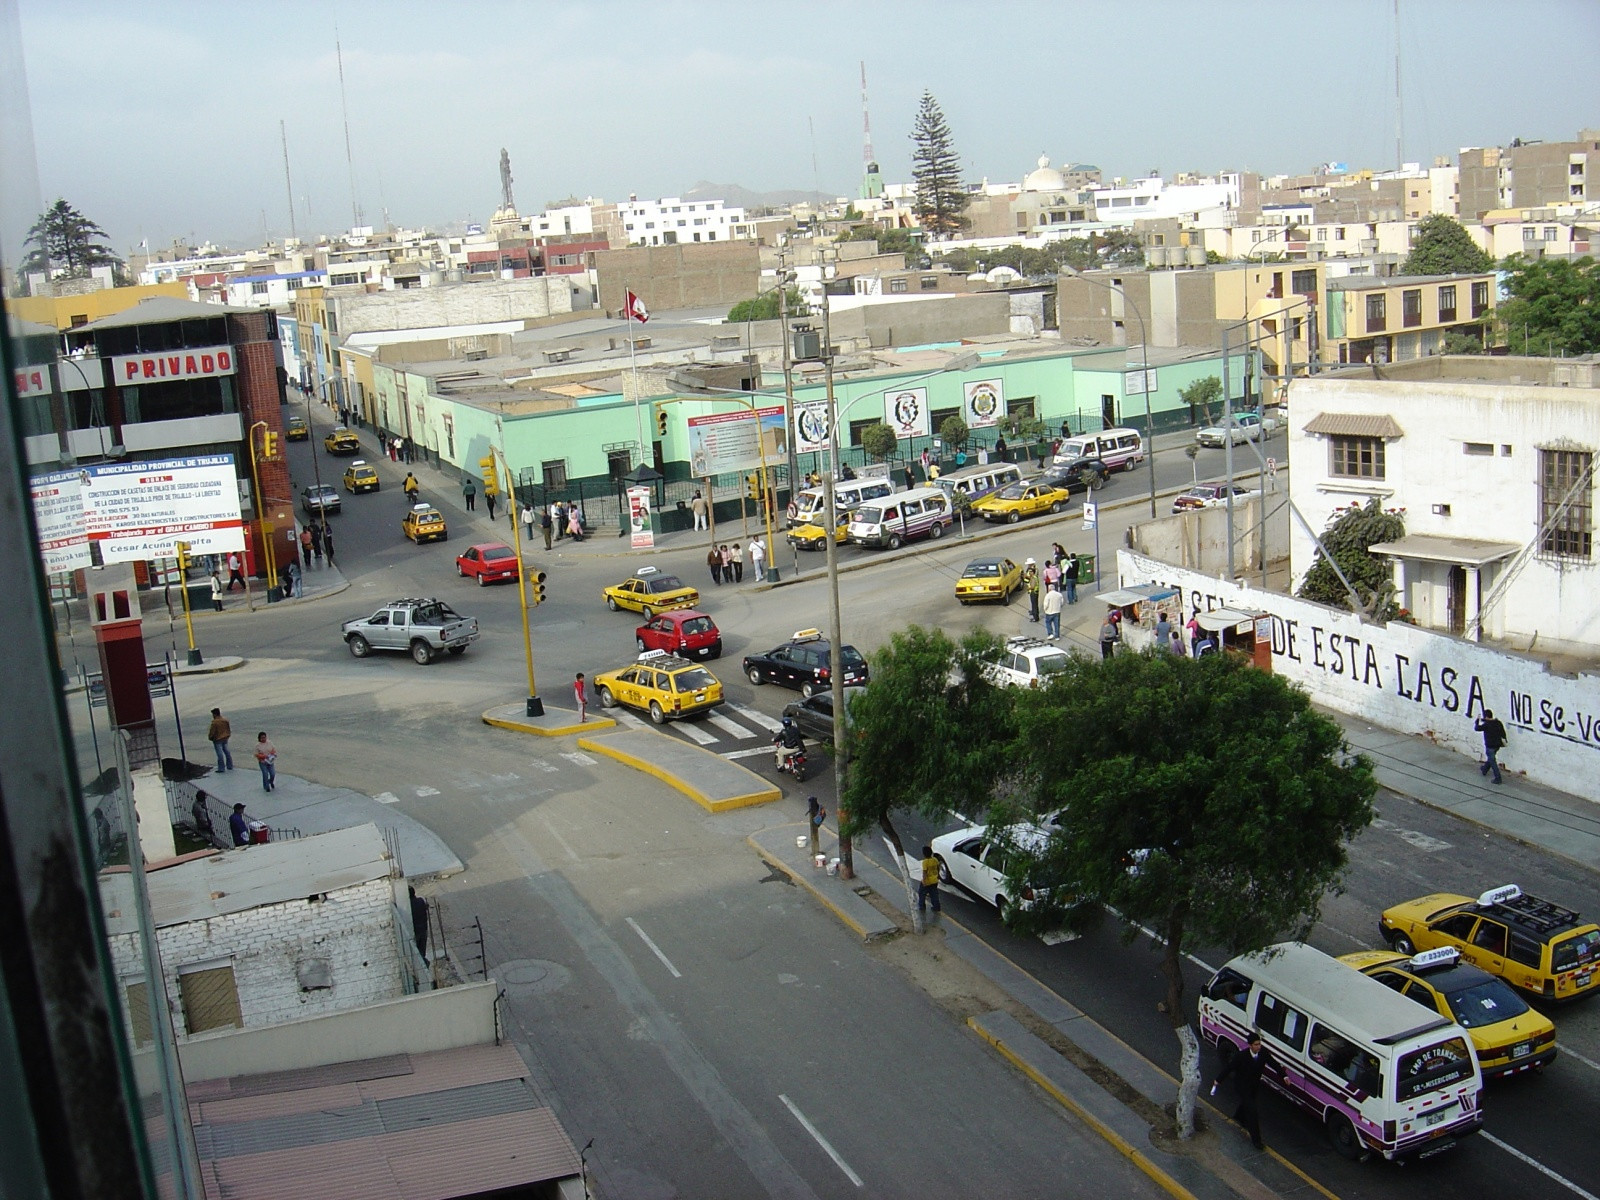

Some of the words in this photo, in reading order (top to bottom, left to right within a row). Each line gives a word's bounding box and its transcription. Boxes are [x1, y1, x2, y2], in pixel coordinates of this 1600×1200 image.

[125, 351, 231, 380] PRIVADO
[97, 463, 147, 475] MUNICIPALIDAD
[148, 460, 186, 470] PROVINCIAL
[187, 459, 196, 467] DE
[197, 456, 229, 466] TRUJILLO
[145, 528, 156, 536] por
[165, 525, 183, 533] GRAN
[1270, 613, 1301, 664] DE
[1311, 626, 1383, 689] ESTA
[1395, 653, 1487, 720] CASA
[1510, 690, 1533, 725] NO
[1428, 948, 1454, 960] 233000
[1422, 1051, 1432, 1061] DE
